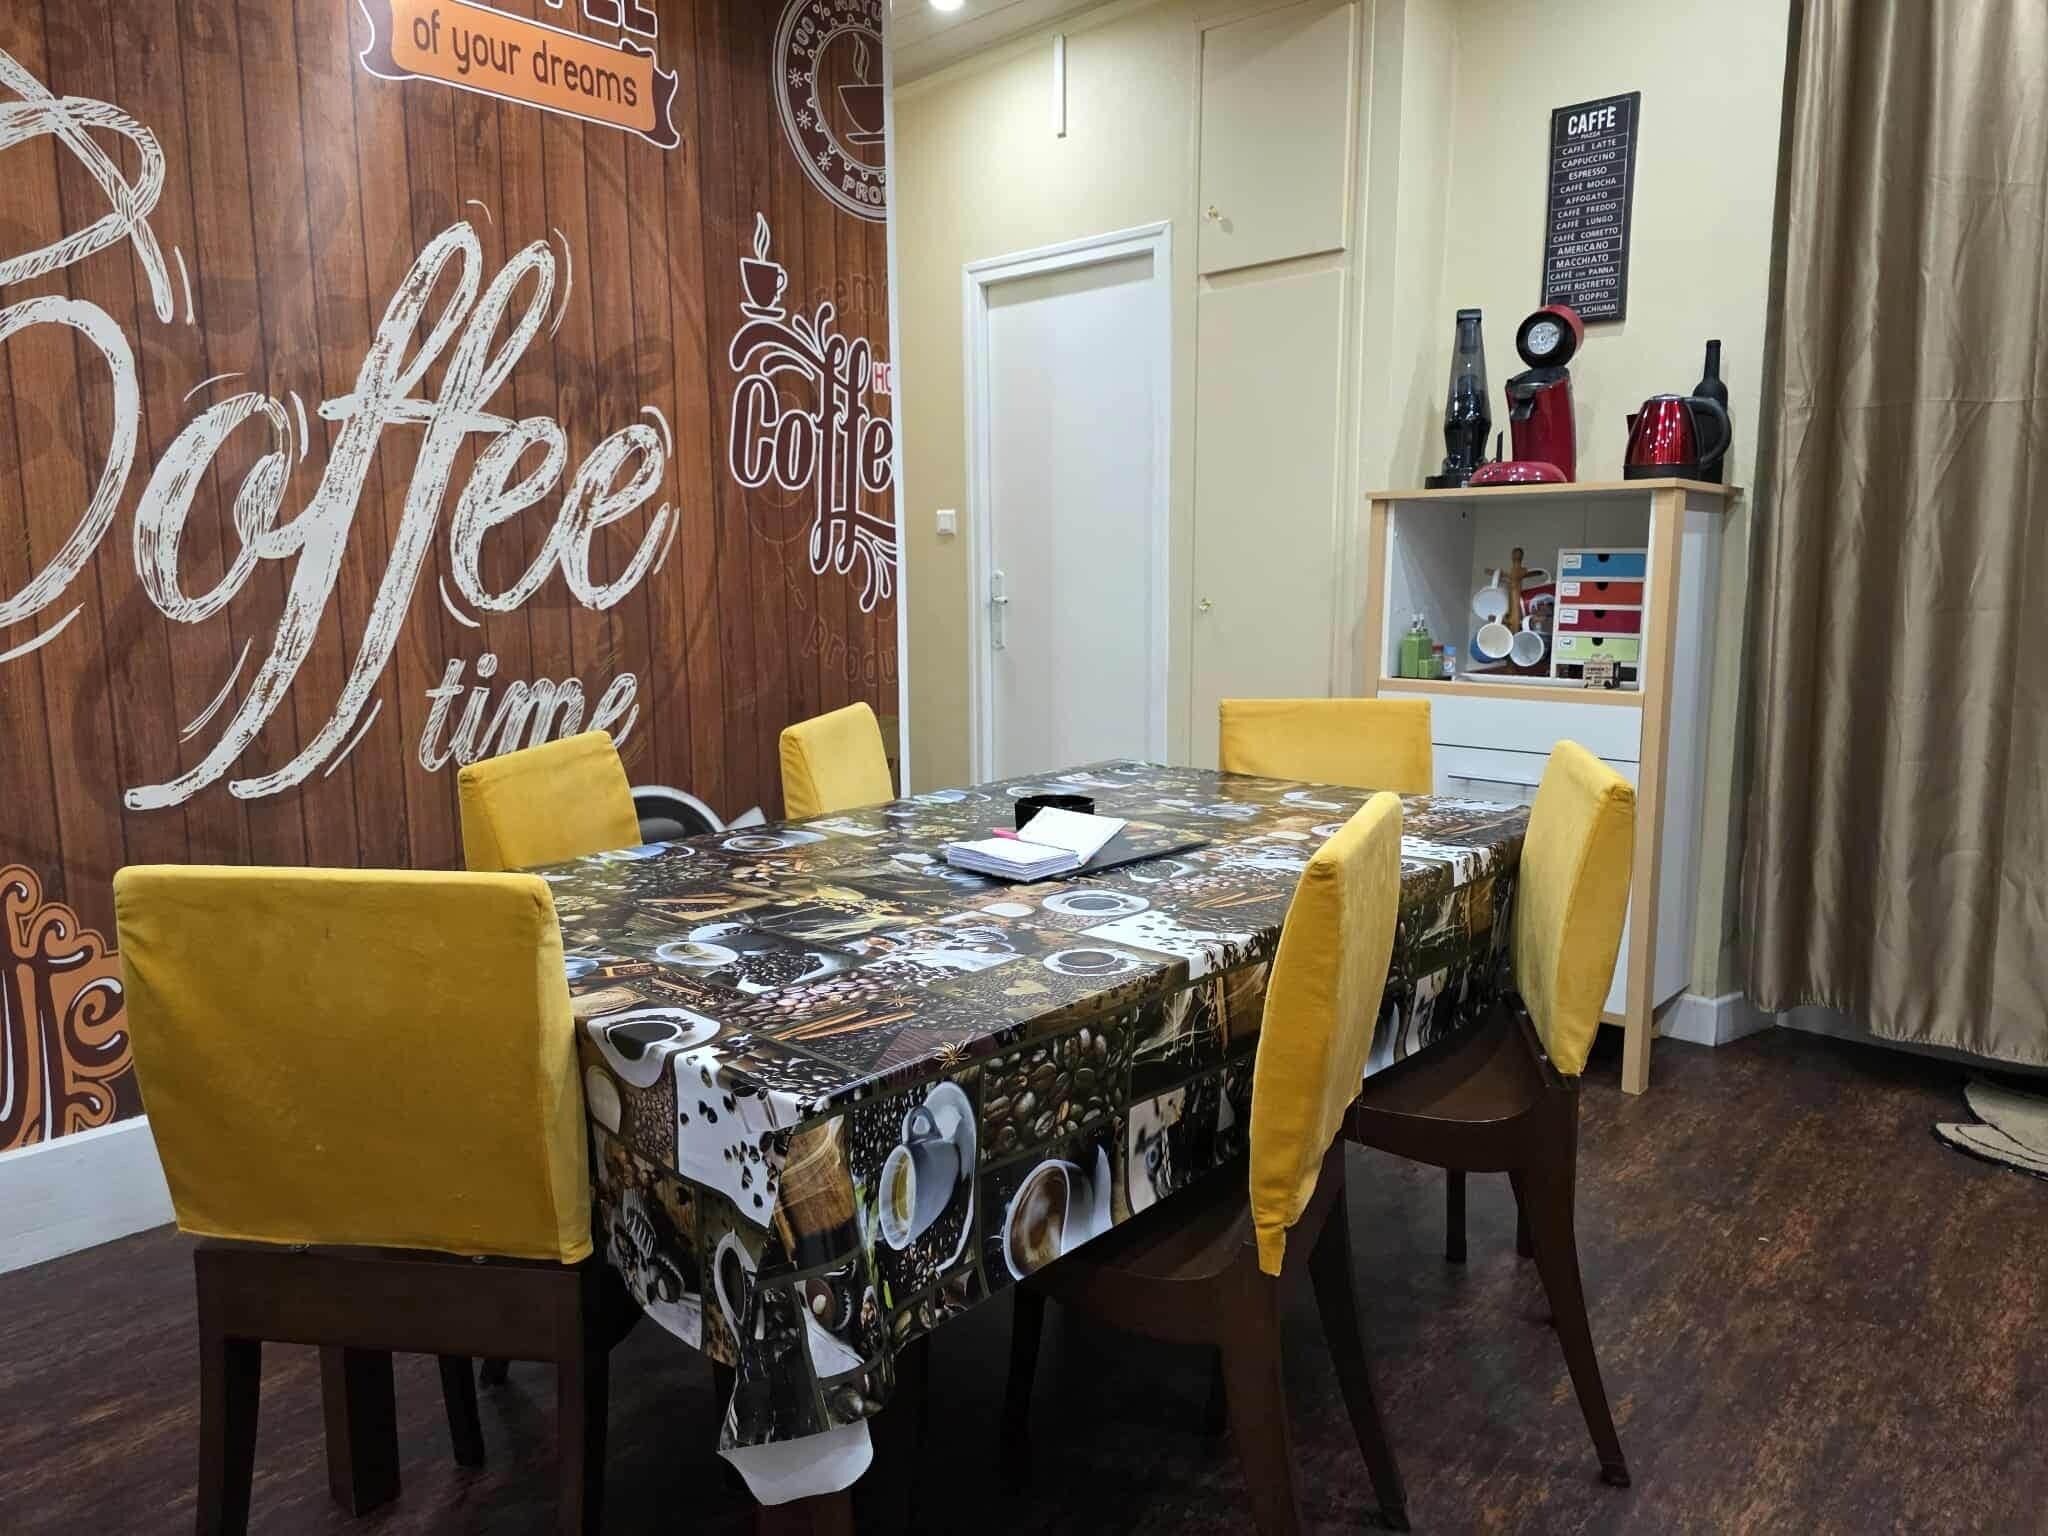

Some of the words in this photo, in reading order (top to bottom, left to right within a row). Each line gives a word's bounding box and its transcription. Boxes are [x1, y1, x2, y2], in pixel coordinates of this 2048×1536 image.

[791, 16, 815, 56] 100
[412, 8, 441, 54] of
[452, 26, 521, 75] your
[532, 39, 638, 107] dreams
[1591, 138, 1617, 150] LATTE
[1561, 151, 1616, 169] CAPPUCCINO
[1568, 166, 1608, 181] ESPRESSO
[1586, 177, 1617, 189] MOCHA
[1564, 191, 1608, 206] AFFOGATO
[1586, 201, 1617, 214] FREDDO
[1586, 214, 1614, 227] LUNGO
[1556, 240, 1610, 257] AMERICANO
[1555, 253, 1609, 269] MACCHIATO
[1588, 265, 1615, 276] PANNA
[1574, 278, 1616, 290] RISTRETTO
[1578, 291, 1609, 302] DOPPIO
[1582, 303, 1617, 314] SCHIUMA
[418, 652, 640, 773] time
